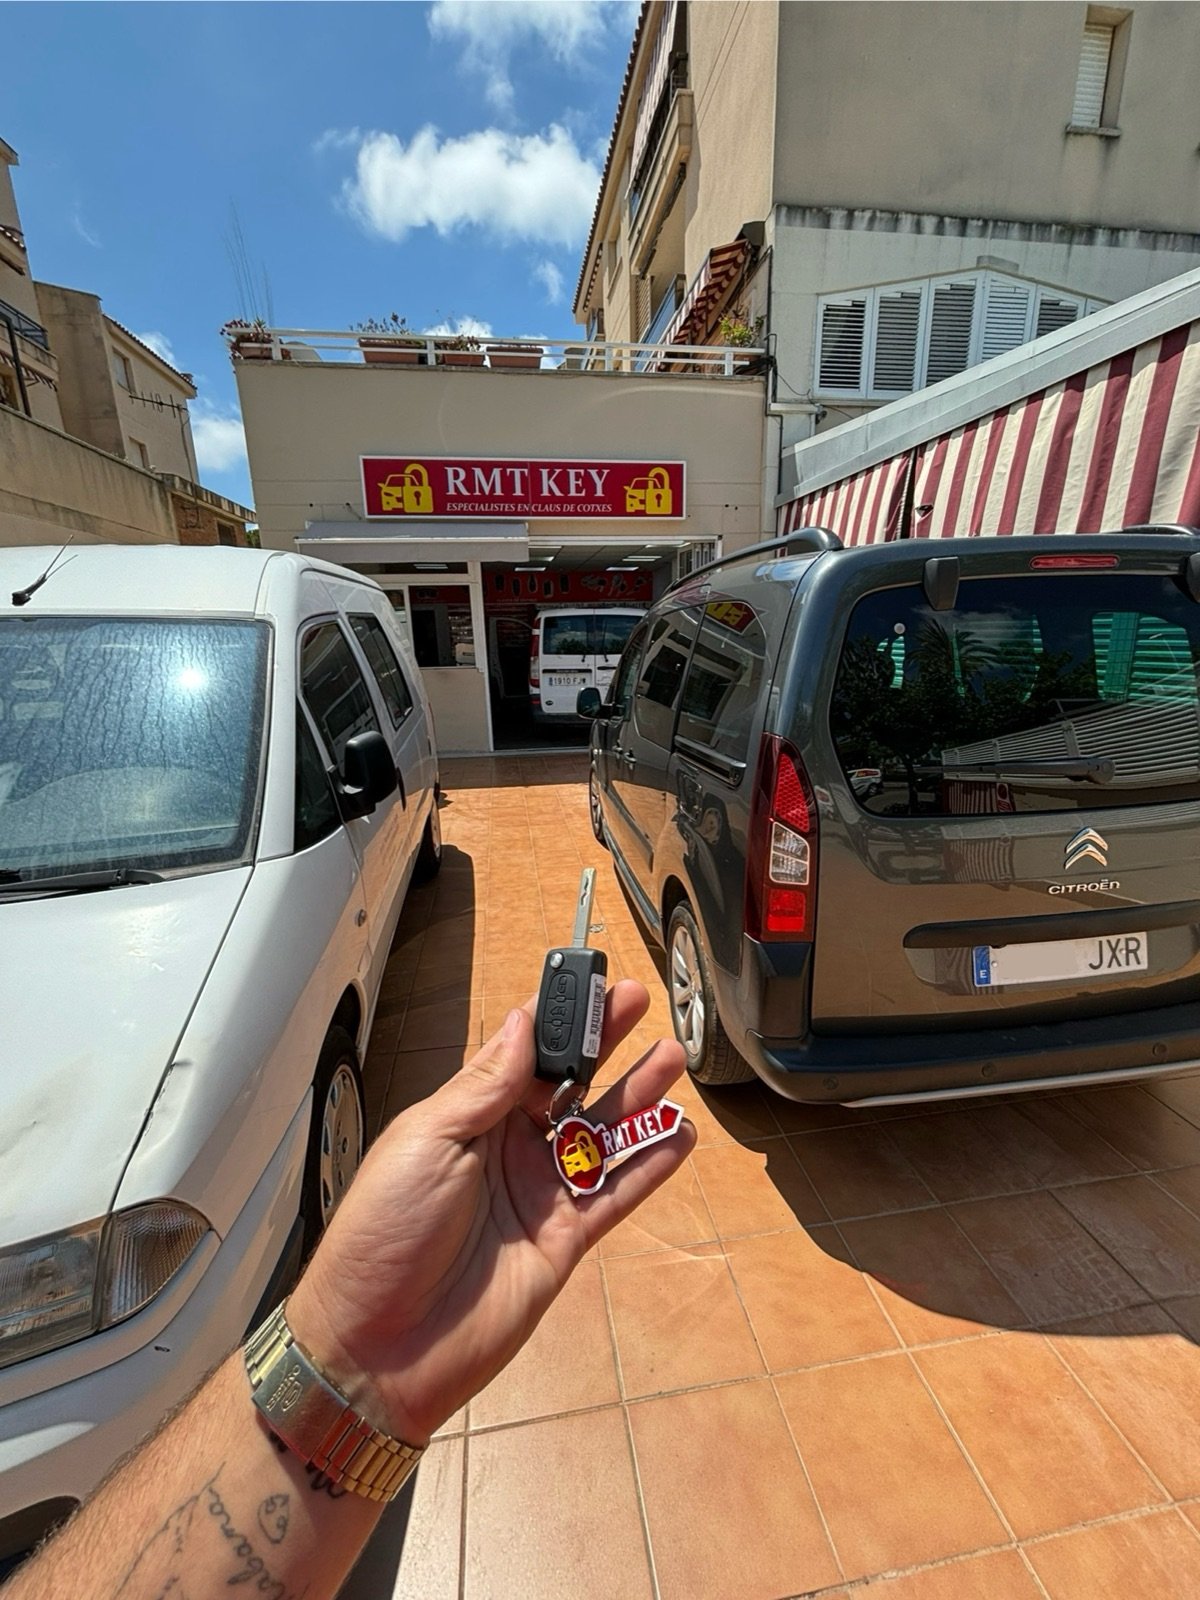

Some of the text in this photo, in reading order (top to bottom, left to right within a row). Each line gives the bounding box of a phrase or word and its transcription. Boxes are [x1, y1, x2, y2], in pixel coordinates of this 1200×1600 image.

[444, 466, 610, 497] RMT KEY
[446, 502, 613, 513] ESPECIALISTES EN CLAUS DE COTXES
[1088, 937, 1141, 970] JXR
[601, 1107, 664, 1154] RMT KEY
[266, 1363, 302, 1412] SEIKO
